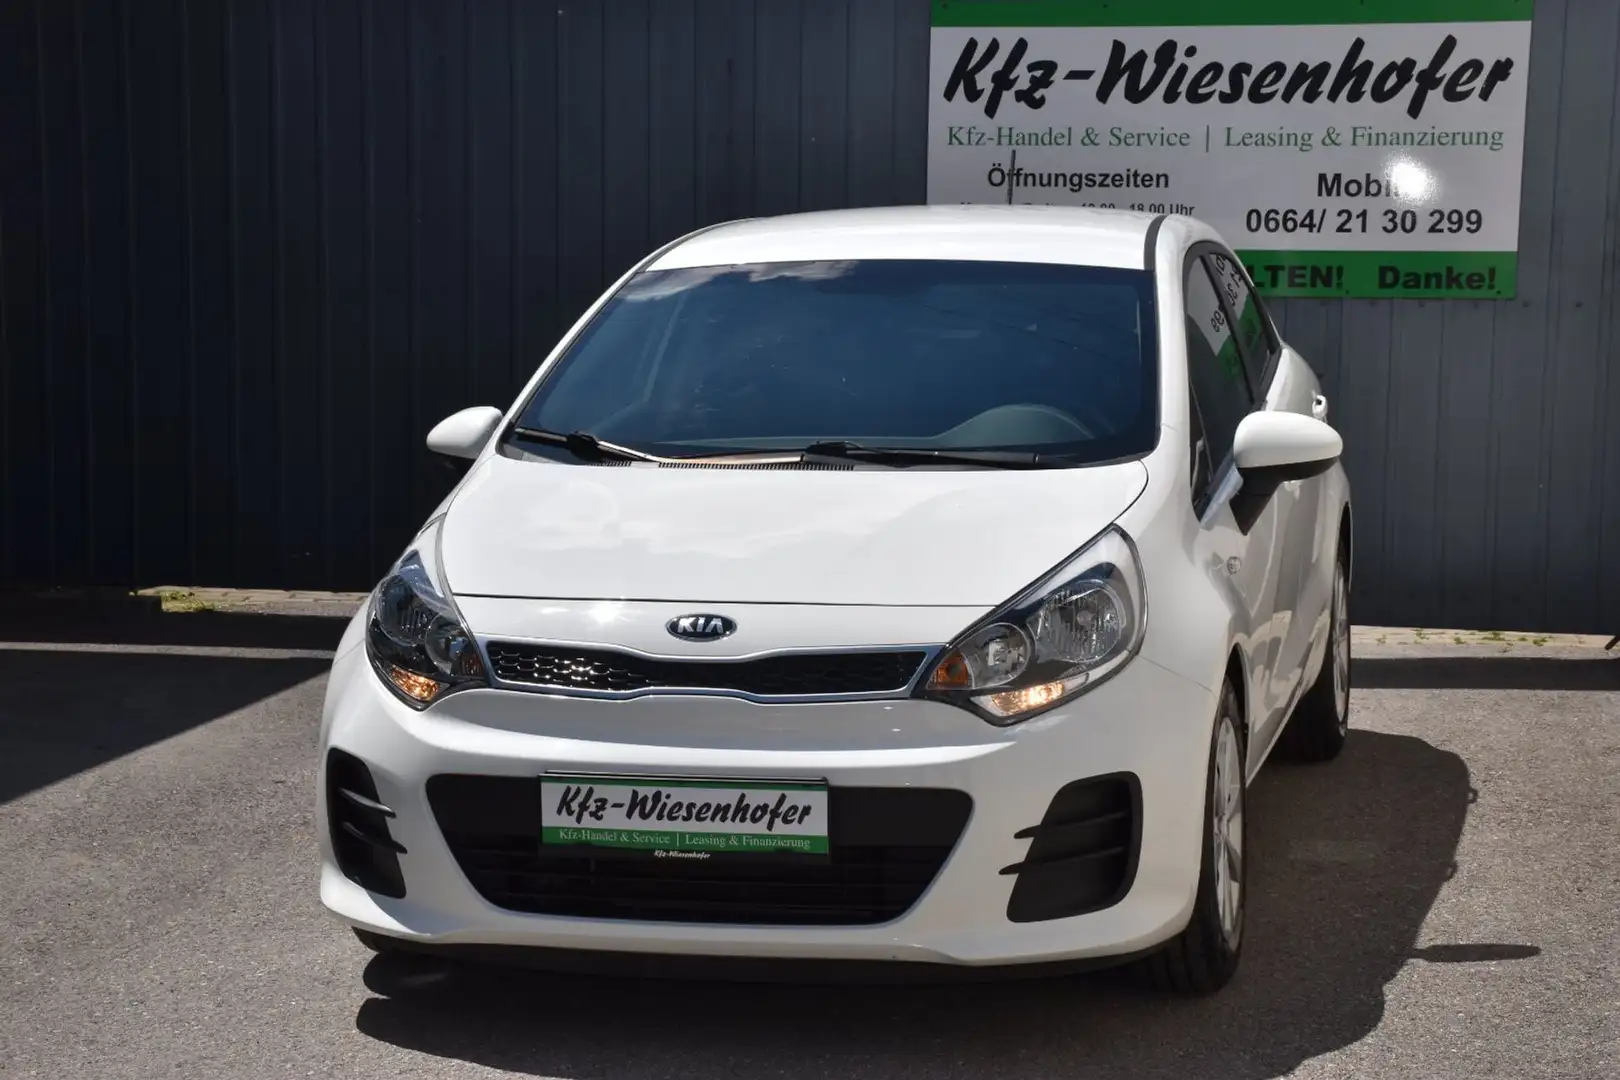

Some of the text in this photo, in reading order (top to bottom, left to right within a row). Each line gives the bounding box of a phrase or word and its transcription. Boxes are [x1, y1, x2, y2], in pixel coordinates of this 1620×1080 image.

[943, 34, 1514, 120] Kfz-Wiesenhofer
[947, 125, 1504, 152] Kfz-Handel & Service Leasing & Finanzierung
[987, 162, 1169, 193] Öffnungszeiten
[1169, 203, 1195, 216] Uhr
[1246, 208, 1483, 234] 0664/ 21 30 299
[1378, 265, 1496, 290] Danke!
[677, 616, 724, 634] KIA
[556, 785, 812, 831] Kfz-Wiesenhofer
[559, 829, 811, 851] Kfz-Handel & Service Leasing & Finanzierung
